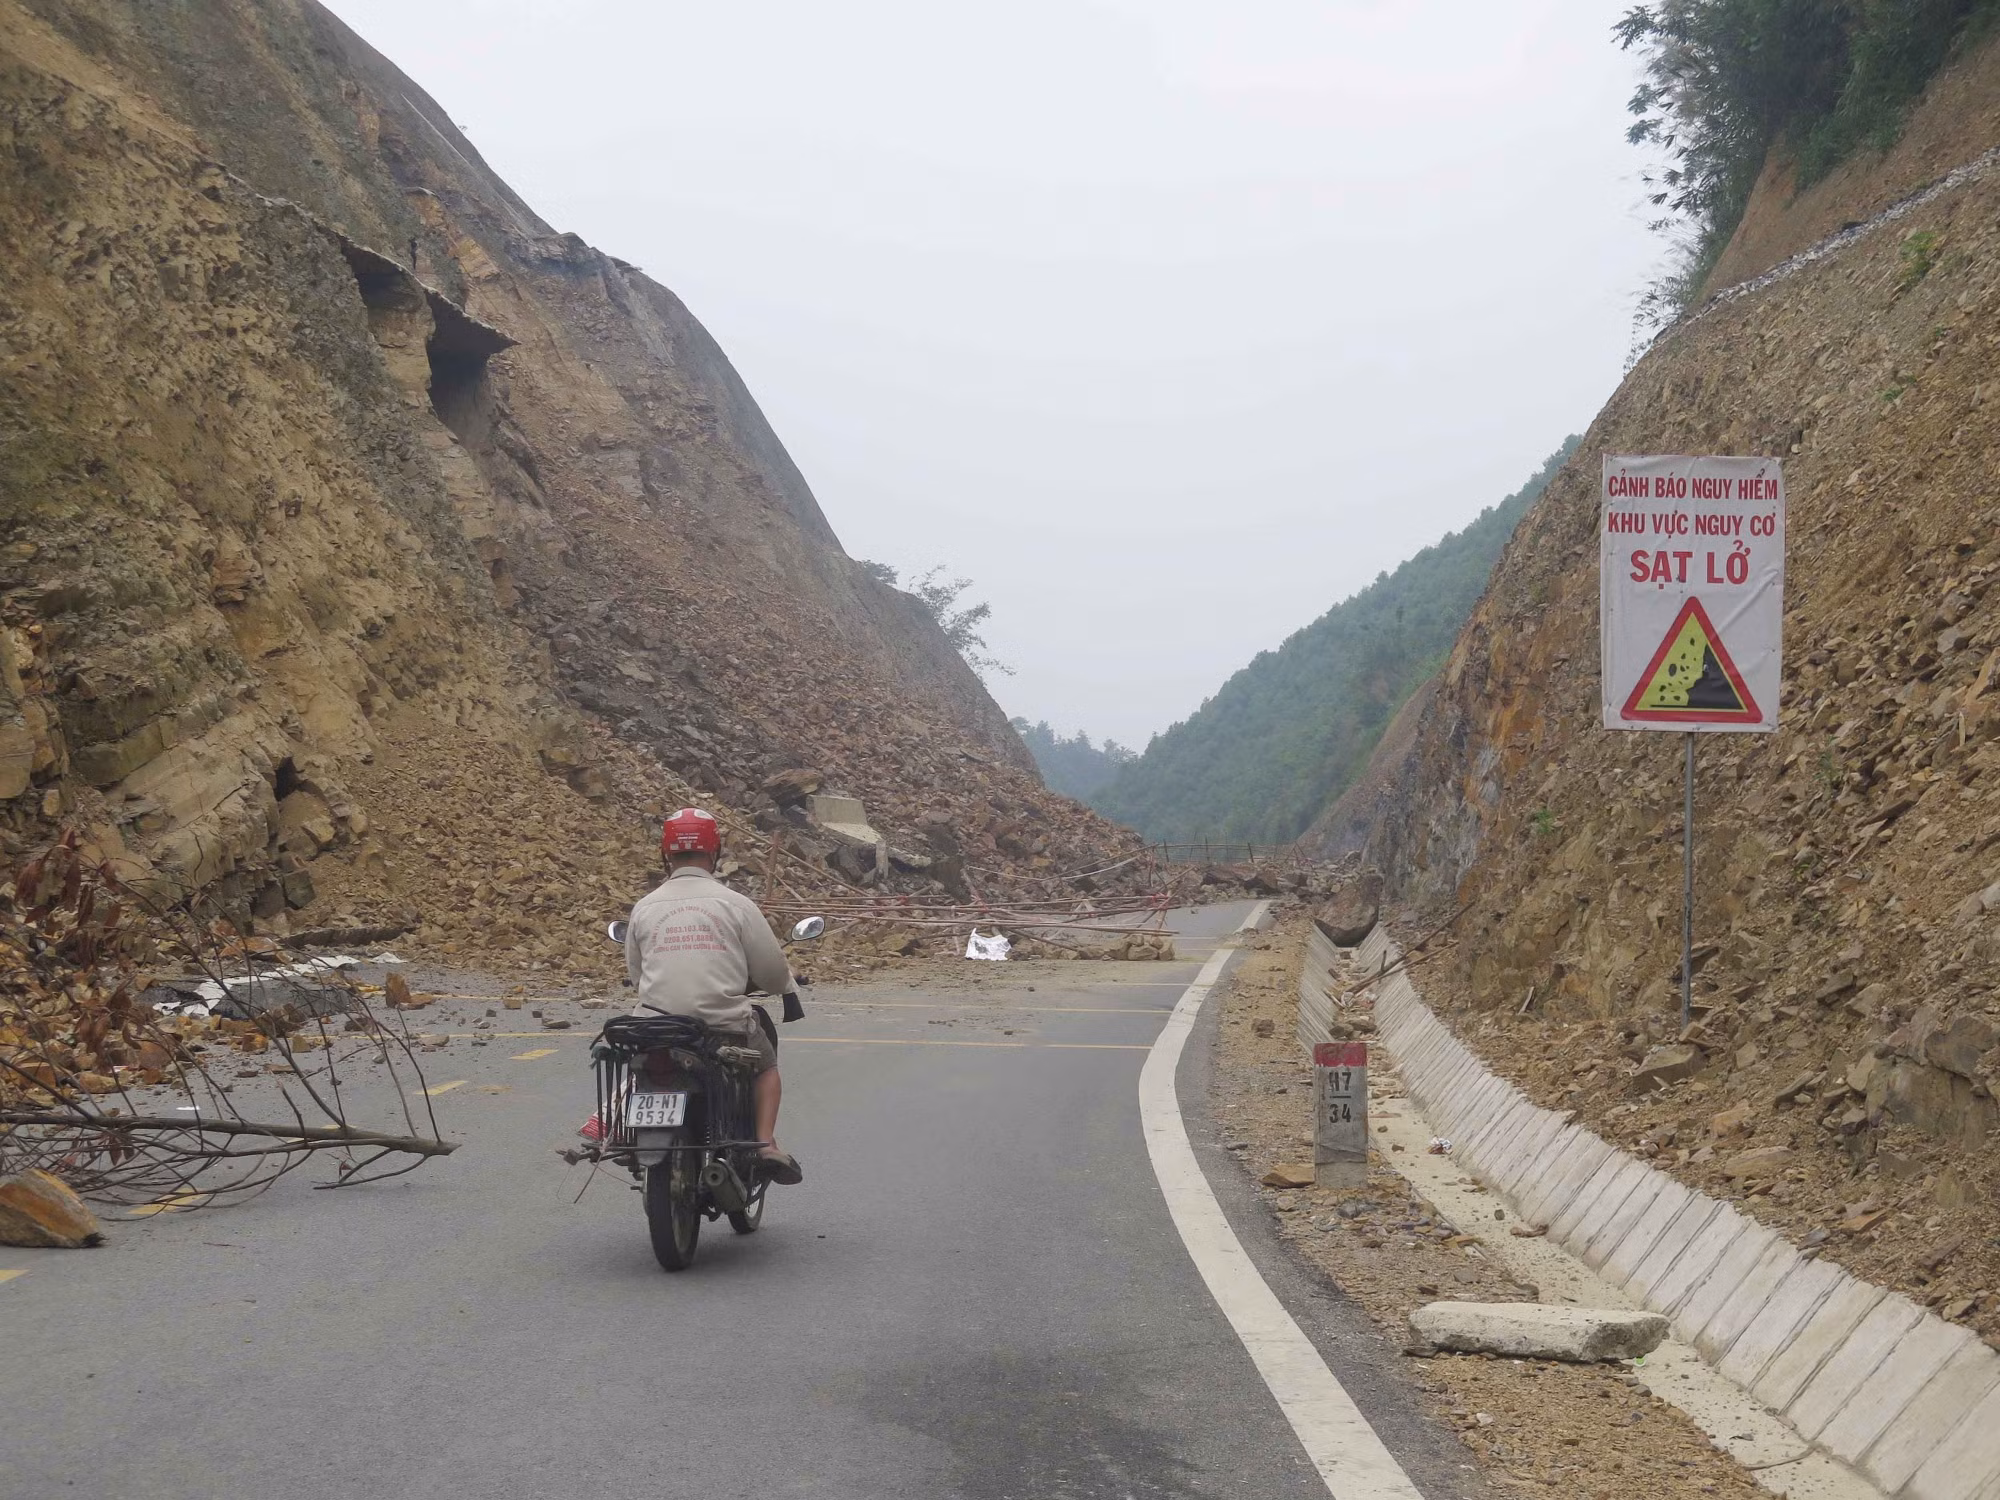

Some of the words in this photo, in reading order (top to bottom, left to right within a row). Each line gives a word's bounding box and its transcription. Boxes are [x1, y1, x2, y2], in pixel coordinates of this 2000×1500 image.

[1608, 468, 1649, 498] CẢNH
[1655, 472, 1687, 499] BÁO
[1692, 478, 1733, 500] NGUY
[1738, 468, 1778, 500] HIỂM
[1608, 512, 1646, 534] KHU
[1652, 510, 1689, 539] VỰC
[1695, 514, 1744, 536] NGUY
[1750, 512, 1776, 536] CƠ
[1630, 549, 1693, 590] SẠT
[1706, 539, 1751, 585] LỞ
[638, 1094, 678, 1109] 20-N1
[1329, 1103, 1352, 1123] 34
[635, 1110, 676, 1125] 9534
